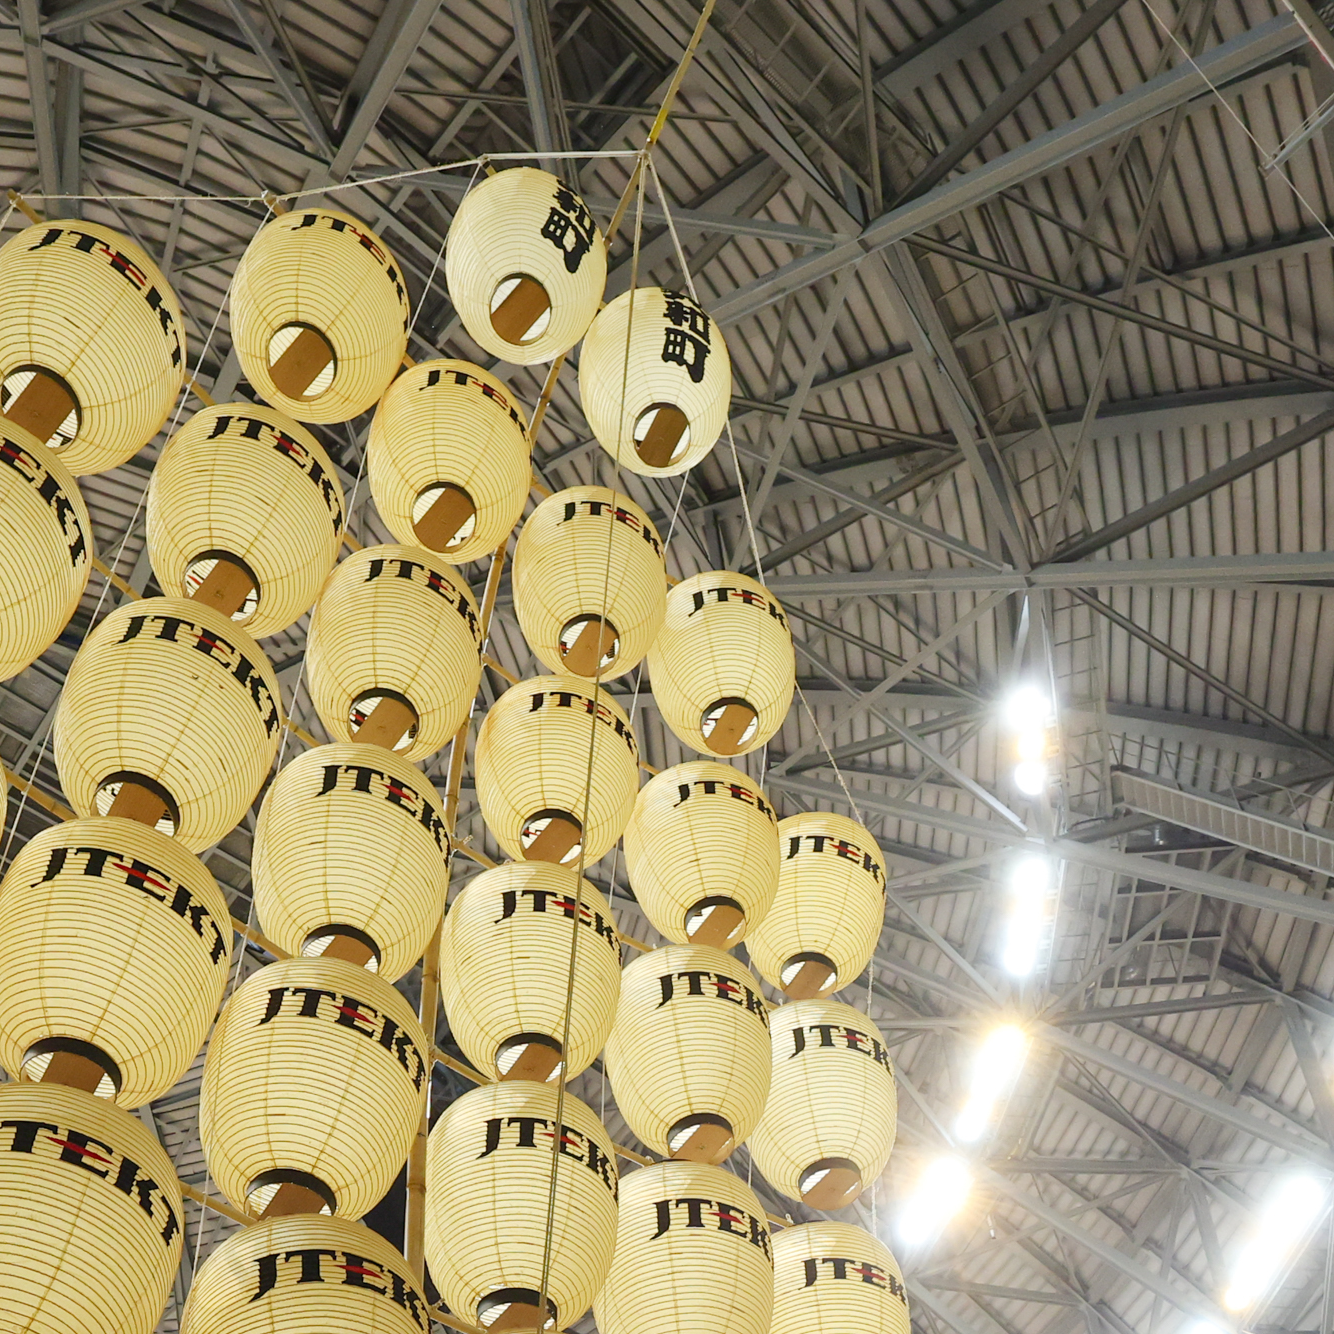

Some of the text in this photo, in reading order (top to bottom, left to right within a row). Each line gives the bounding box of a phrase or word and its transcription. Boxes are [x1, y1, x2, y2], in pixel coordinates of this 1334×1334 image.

[291, 214, 409, 335] JTEK
[419, 370, 533, 467] JTEK
[529, 692, 639, 767] JTEK
[495, 890, 622, 966] JTEK
[655, 971, 771, 1040] JTEK
[476, 1117, 618, 1206] JTEK
[650, 1198, 774, 1272] JTEK
